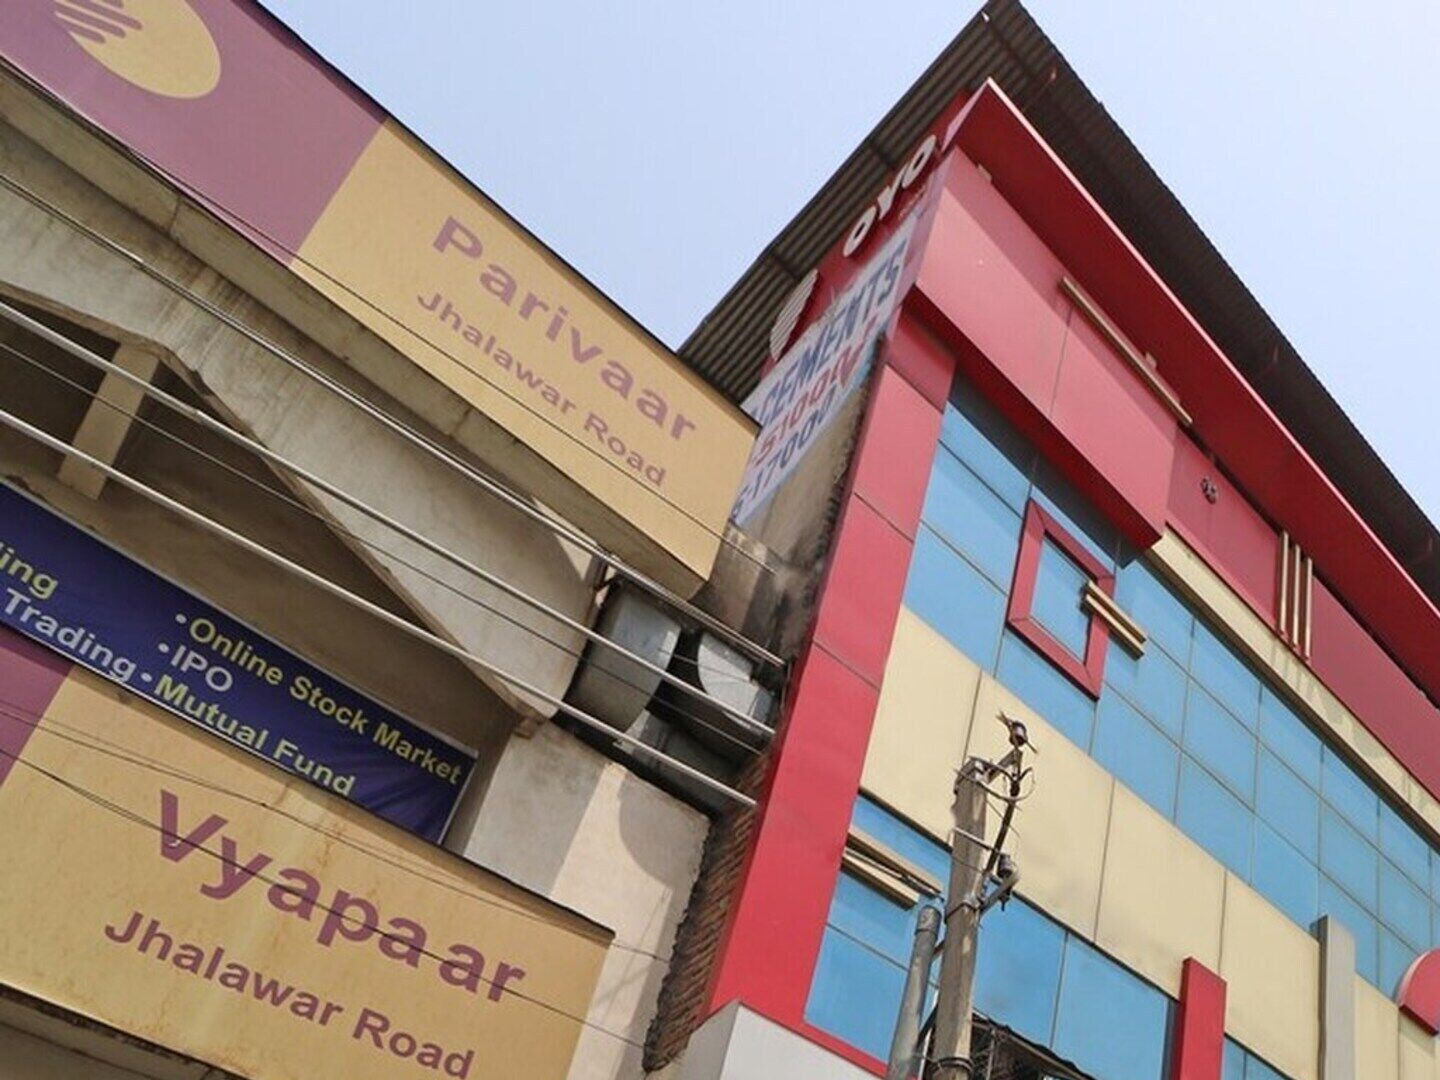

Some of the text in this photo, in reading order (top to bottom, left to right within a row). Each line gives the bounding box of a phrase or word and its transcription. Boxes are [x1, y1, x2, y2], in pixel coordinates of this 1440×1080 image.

[417, 288, 666, 487] Jhalawar Road
[431, 214, 696, 443] Parivaar
[0, 541, 58, 600] ing
[5, 588, 356, 797] Trading Mutual Fund
[171, 646, 234, 693] IPO
[190, 616, 461, 786] Online Stock Market
[158, 788, 526, 1003] Vyapaar
[104, 911, 475, 1080] Jhalawar Road
